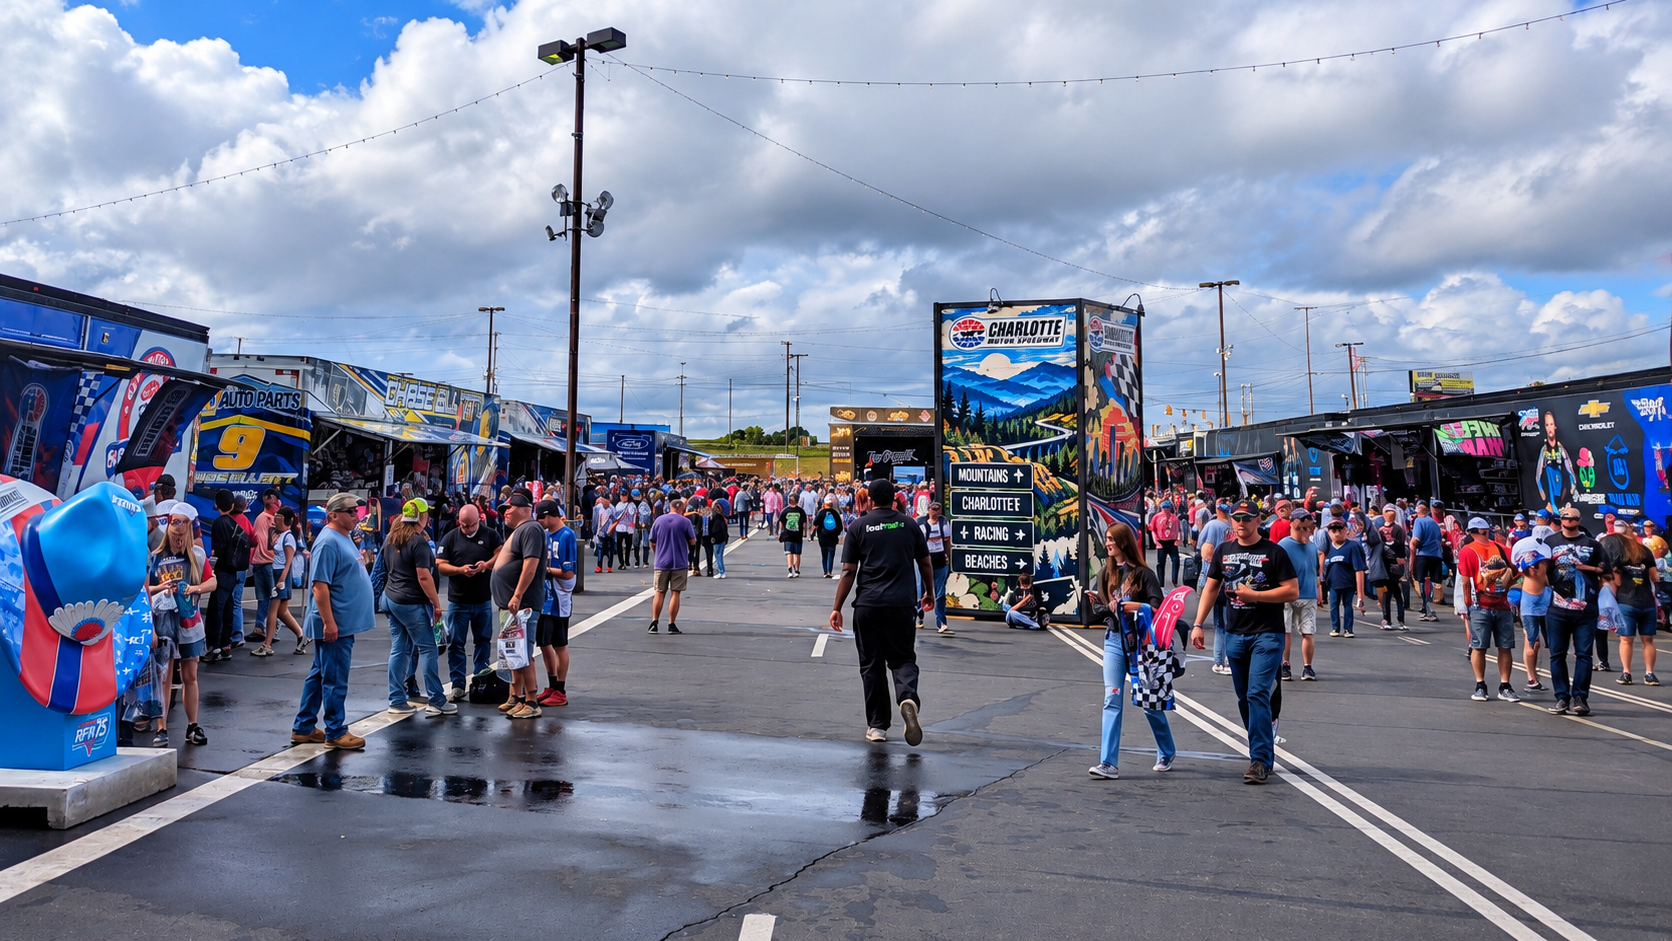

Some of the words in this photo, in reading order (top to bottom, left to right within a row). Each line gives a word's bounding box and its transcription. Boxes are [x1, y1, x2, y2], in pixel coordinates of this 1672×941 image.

[988, 319, 1063, 337] CHARLOTTE
[218, 389, 254, 409] AUTO
[255, 389, 301, 411] PARTS
[212, 424, 267, 470] 9
[958, 468, 1009, 483] MOUNTAINS
[974, 526, 1009, 541] RACING
[965, 554, 1008, 570] BEACHES
